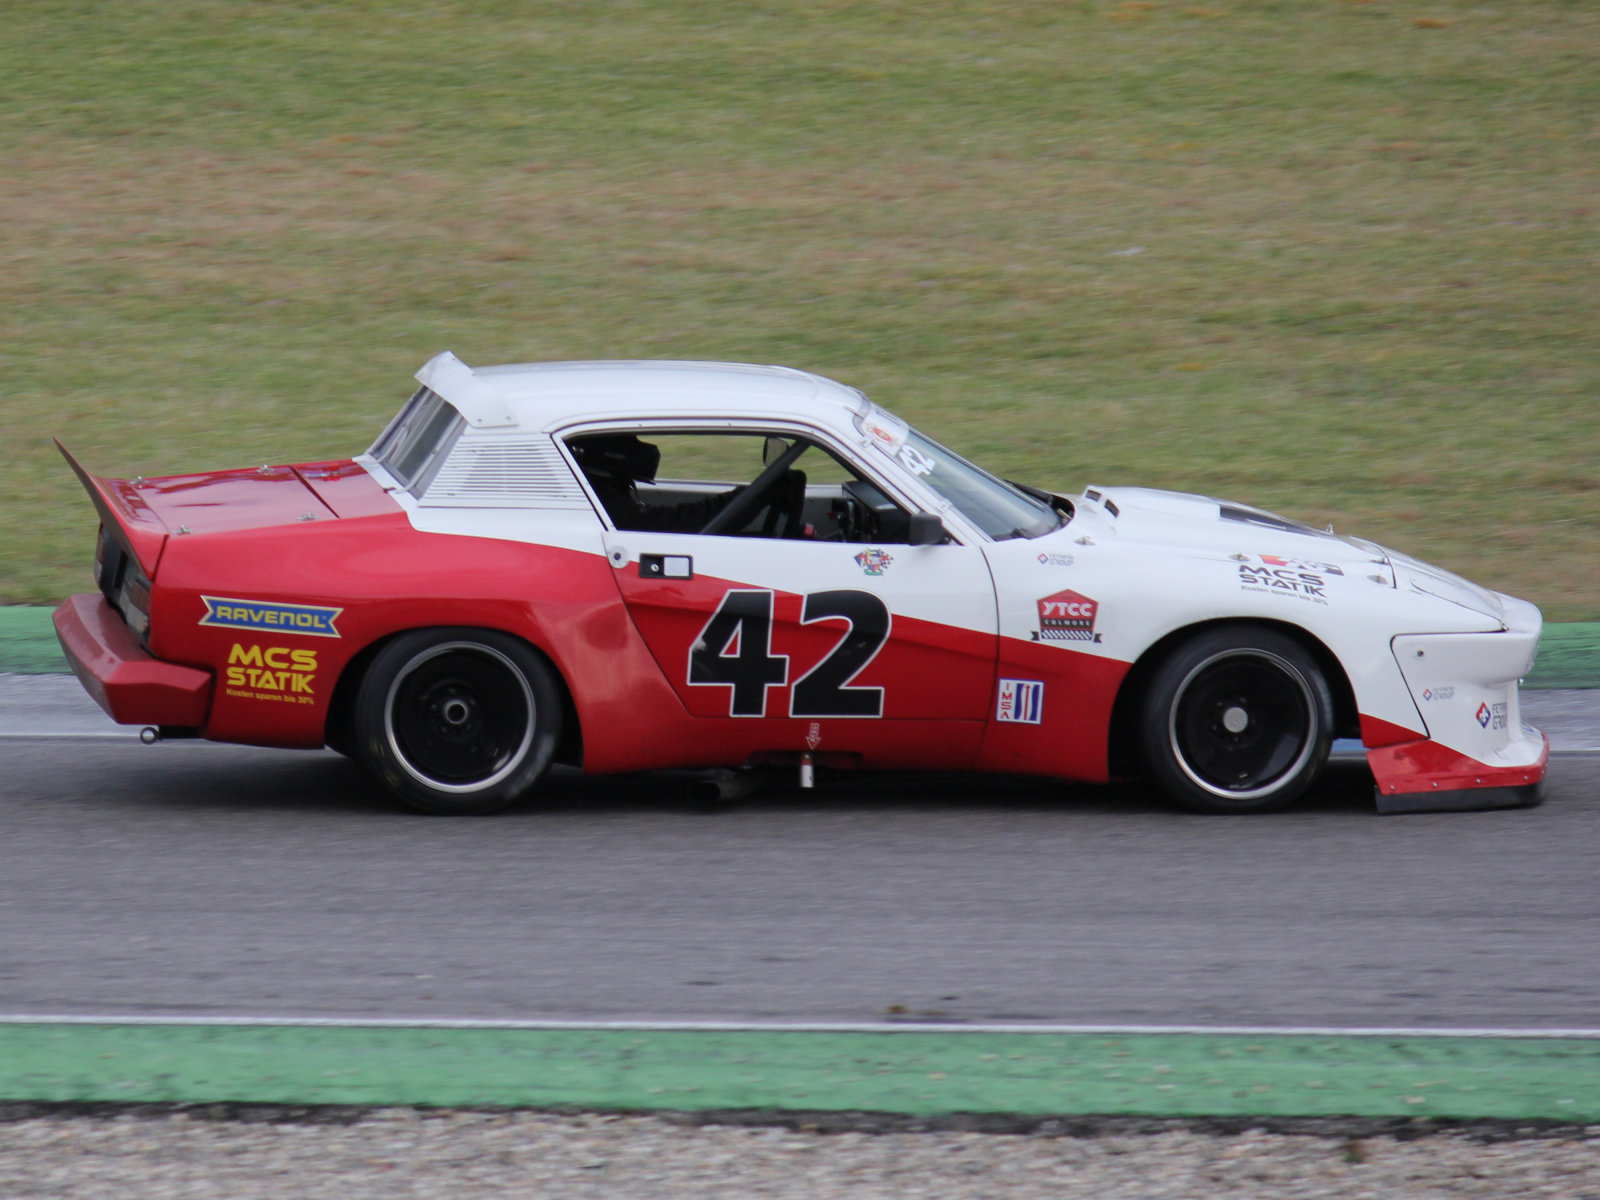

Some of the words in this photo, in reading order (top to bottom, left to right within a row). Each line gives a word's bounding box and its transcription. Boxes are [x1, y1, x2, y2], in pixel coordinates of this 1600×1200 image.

[899, 443, 936, 476] 42
[1239, 564, 1325, 586] MCS
[1239, 573, 1327, 598] STATIK
[1241, 585, 1270, 593] Kosten
[1271, 589, 1298, 599] sparen
[1299, 593, 1311, 602] bis
[216, 606, 327, 628] RAVENOL
[1043, 601, 1093, 617] YTCC
[1044, 618, 1091, 627] COLMORE
[228, 643, 318, 671] MCS
[687, 587, 892, 718] 42
[226, 666, 316, 694] STATIK
[226, 688, 255, 699] Kosten
[255, 692, 283, 702] sparen
[283, 694, 297, 704] bis
[1000, 682, 1013, 720] IMSA
